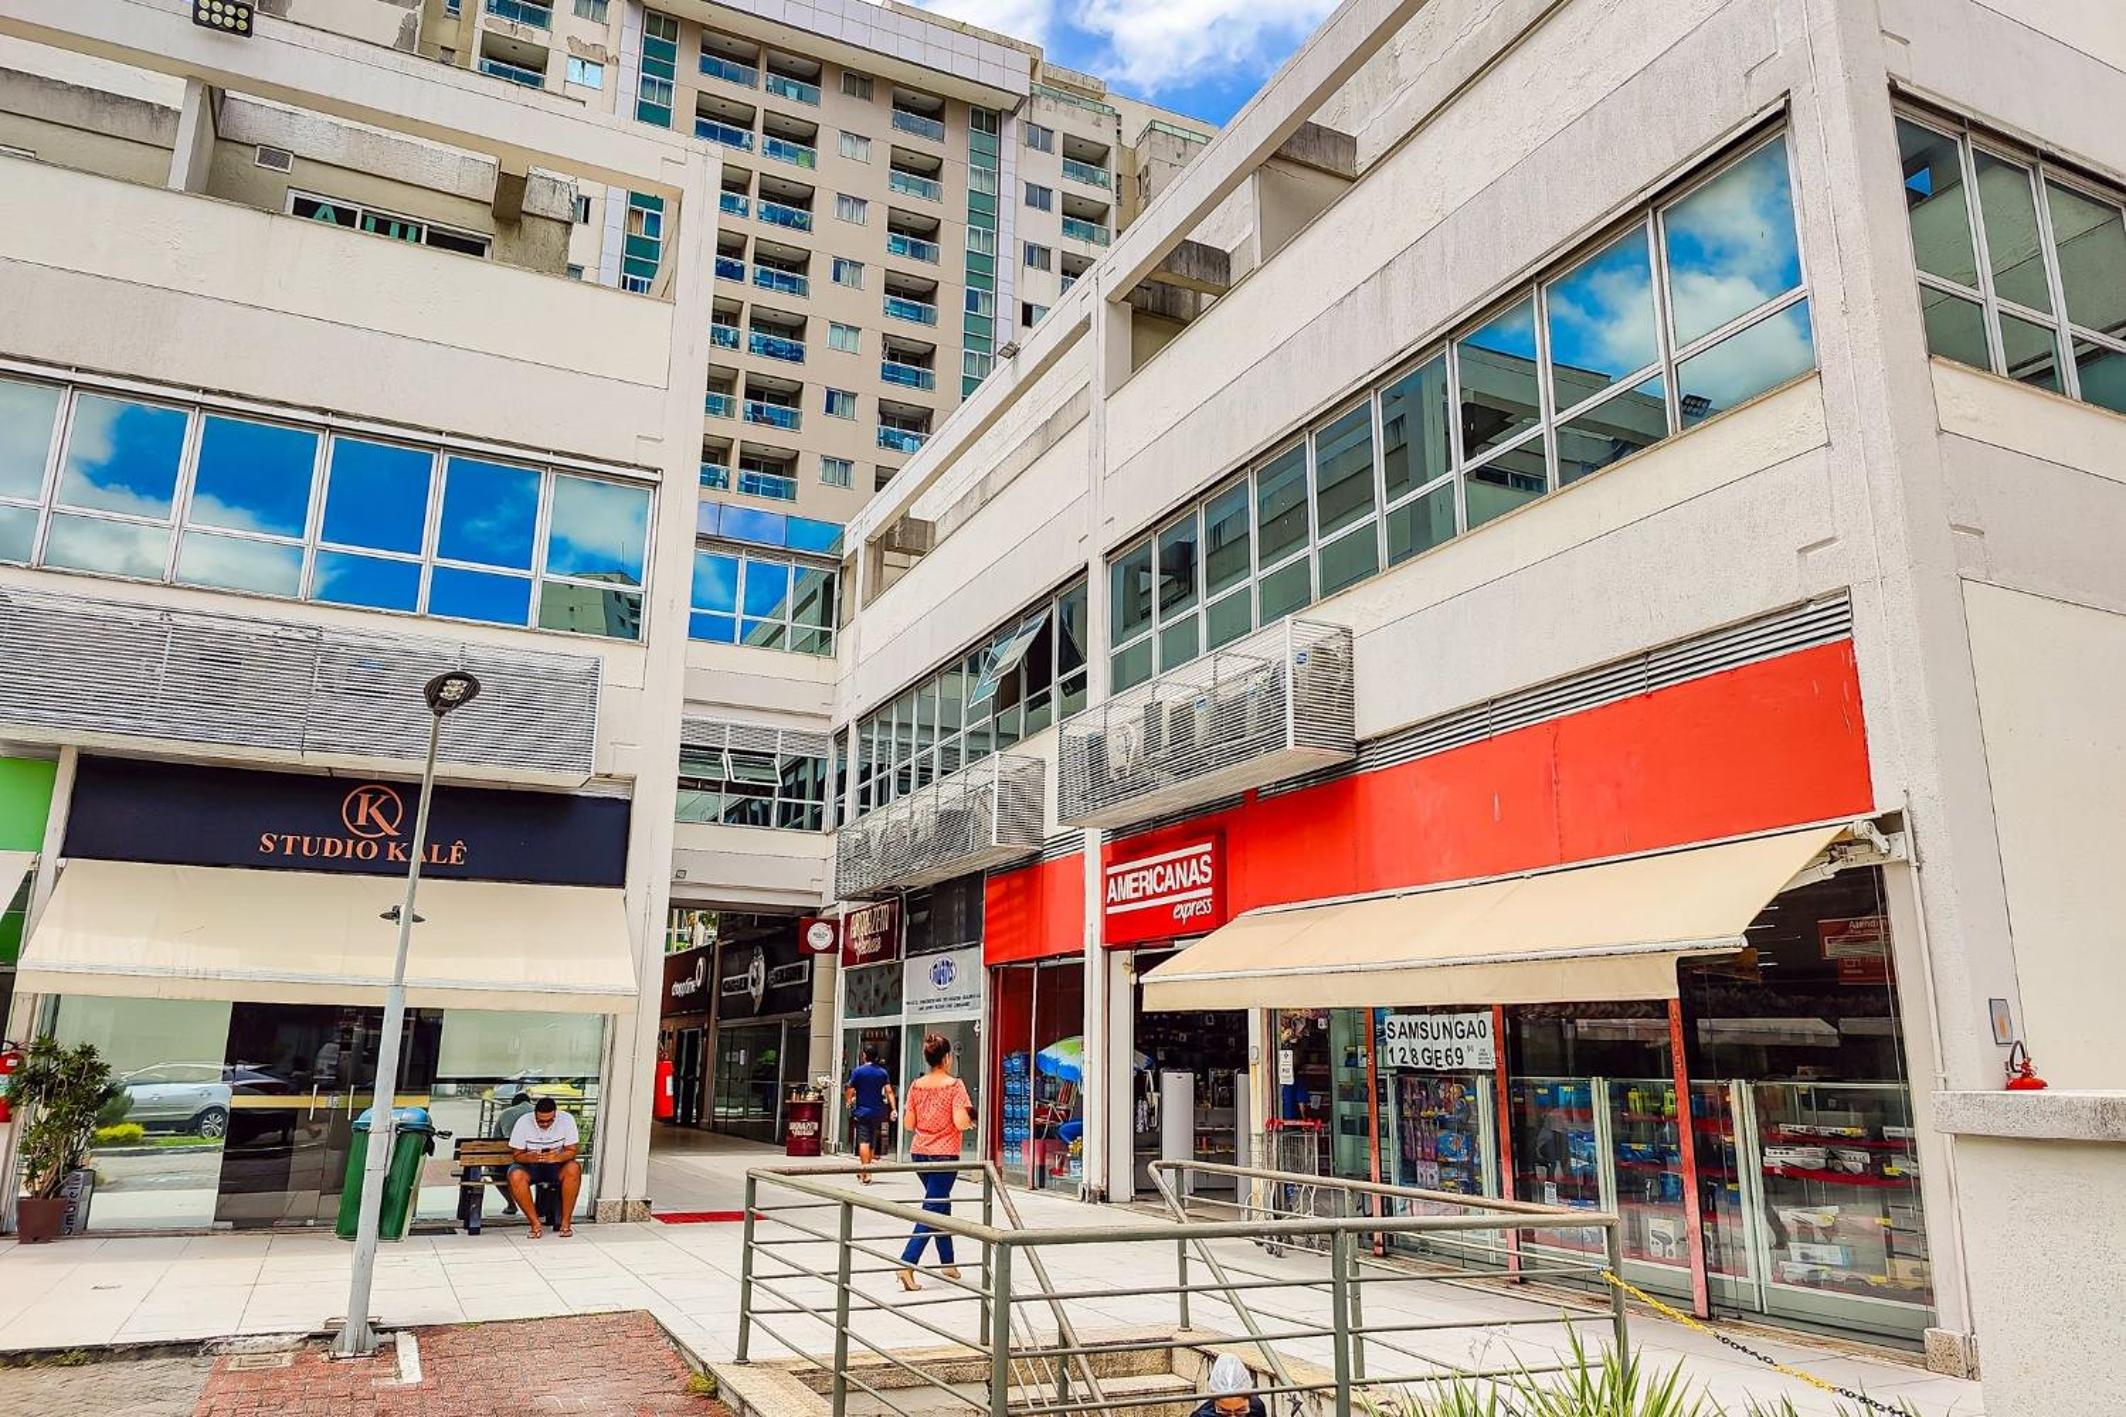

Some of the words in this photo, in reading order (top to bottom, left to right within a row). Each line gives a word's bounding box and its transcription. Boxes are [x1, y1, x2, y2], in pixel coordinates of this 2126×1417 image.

[353, 792, 402, 836] K
[259, 832, 378, 861] STUDIO
[1106, 854, 1213, 904] AMERICANAS
[1173, 898, 1213, 925] express
